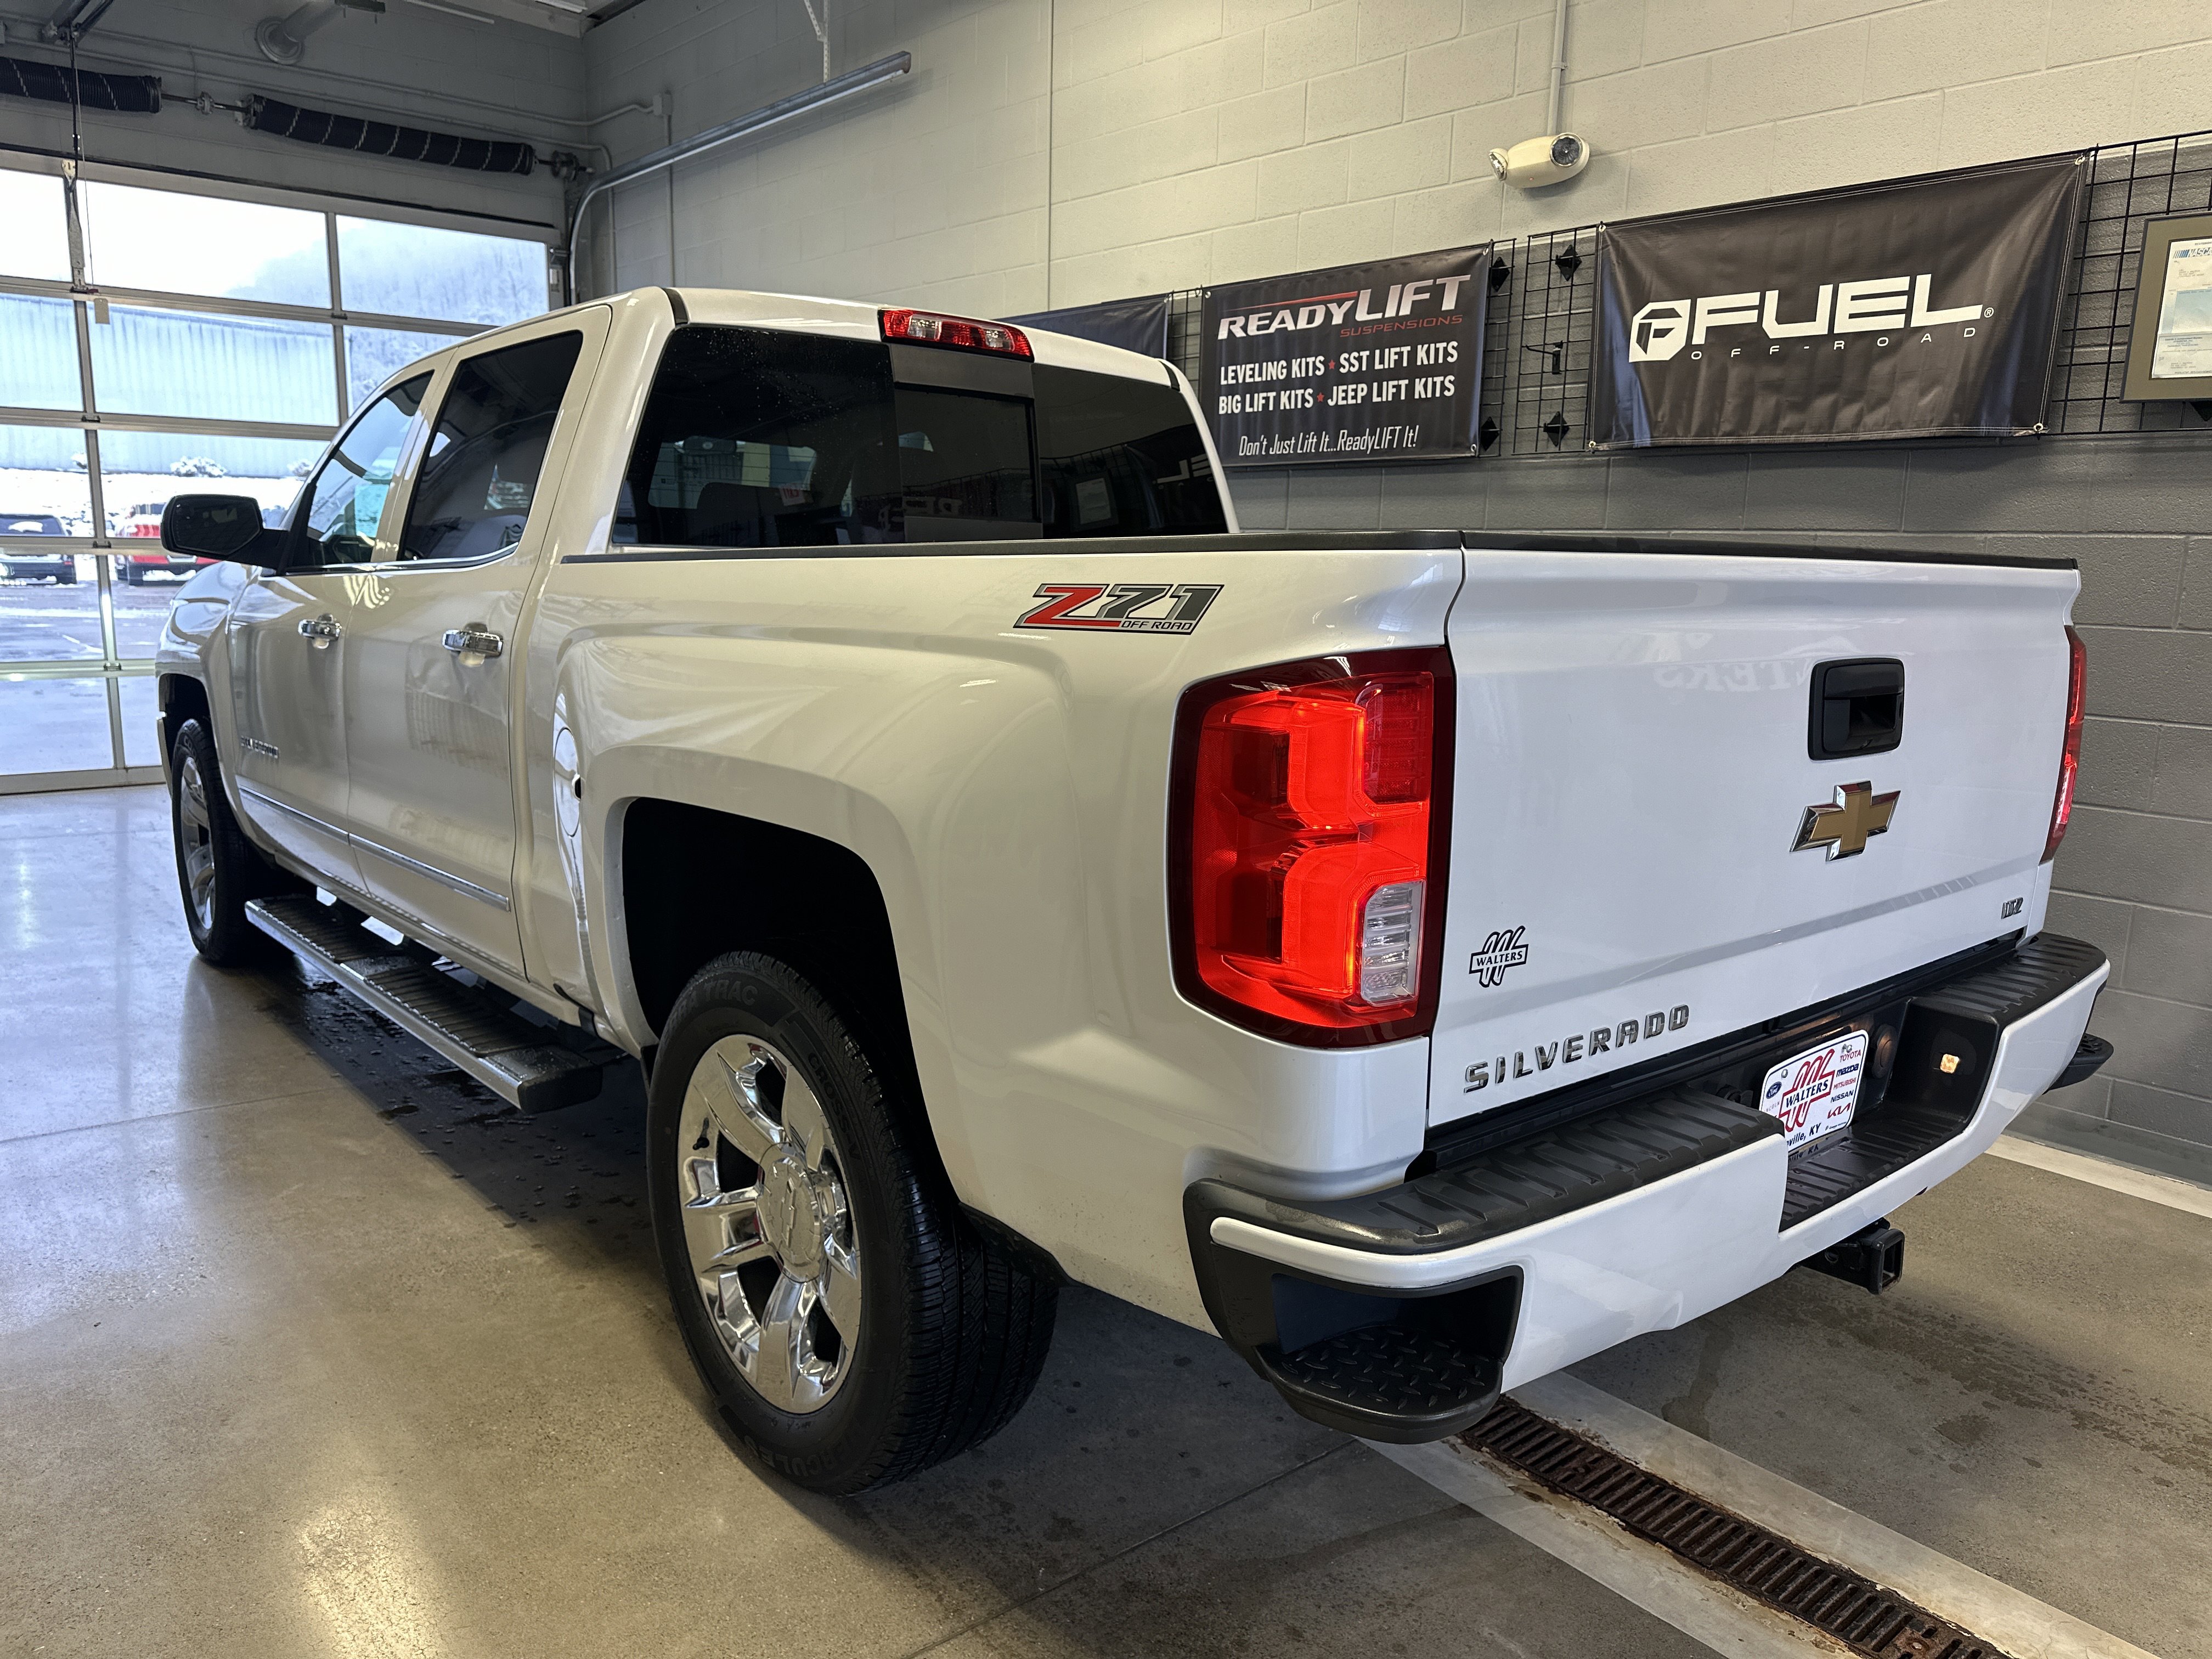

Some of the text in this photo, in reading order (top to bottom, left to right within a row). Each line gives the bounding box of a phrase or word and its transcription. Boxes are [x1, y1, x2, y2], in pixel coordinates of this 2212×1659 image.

[1217, 275, 1471, 340] READYLIFT
[1340, 315, 1463, 337] SUSPENSIONS
[1221, 341, 1458, 385] LEVELING KITS SST LIFT KITS
[1218, 375, 1455, 414] BIG LIFT KITS JEEP LIFT KITS
[1239, 435, 1267, 456] Don't
[1269, 434, 1295, 455] Just
[1297, 432, 1317, 453] Lift
[1403, 425, 1419, 448] It!
[1013, 583, 1224, 635] Z71
[1121, 620, 1193, 630] OFF ROAD
[1476, 950, 1522, 967] WALTERS
[1464, 1004, 1689, 1093] SILVERADO
[1840, 1049, 1861, 1063] TOYOTA
[1786, 1079, 1828, 1108] WALTERS
[1830, 1089, 1854, 1103] NISSAN
[1809, 1122, 1821, 1136] KY
